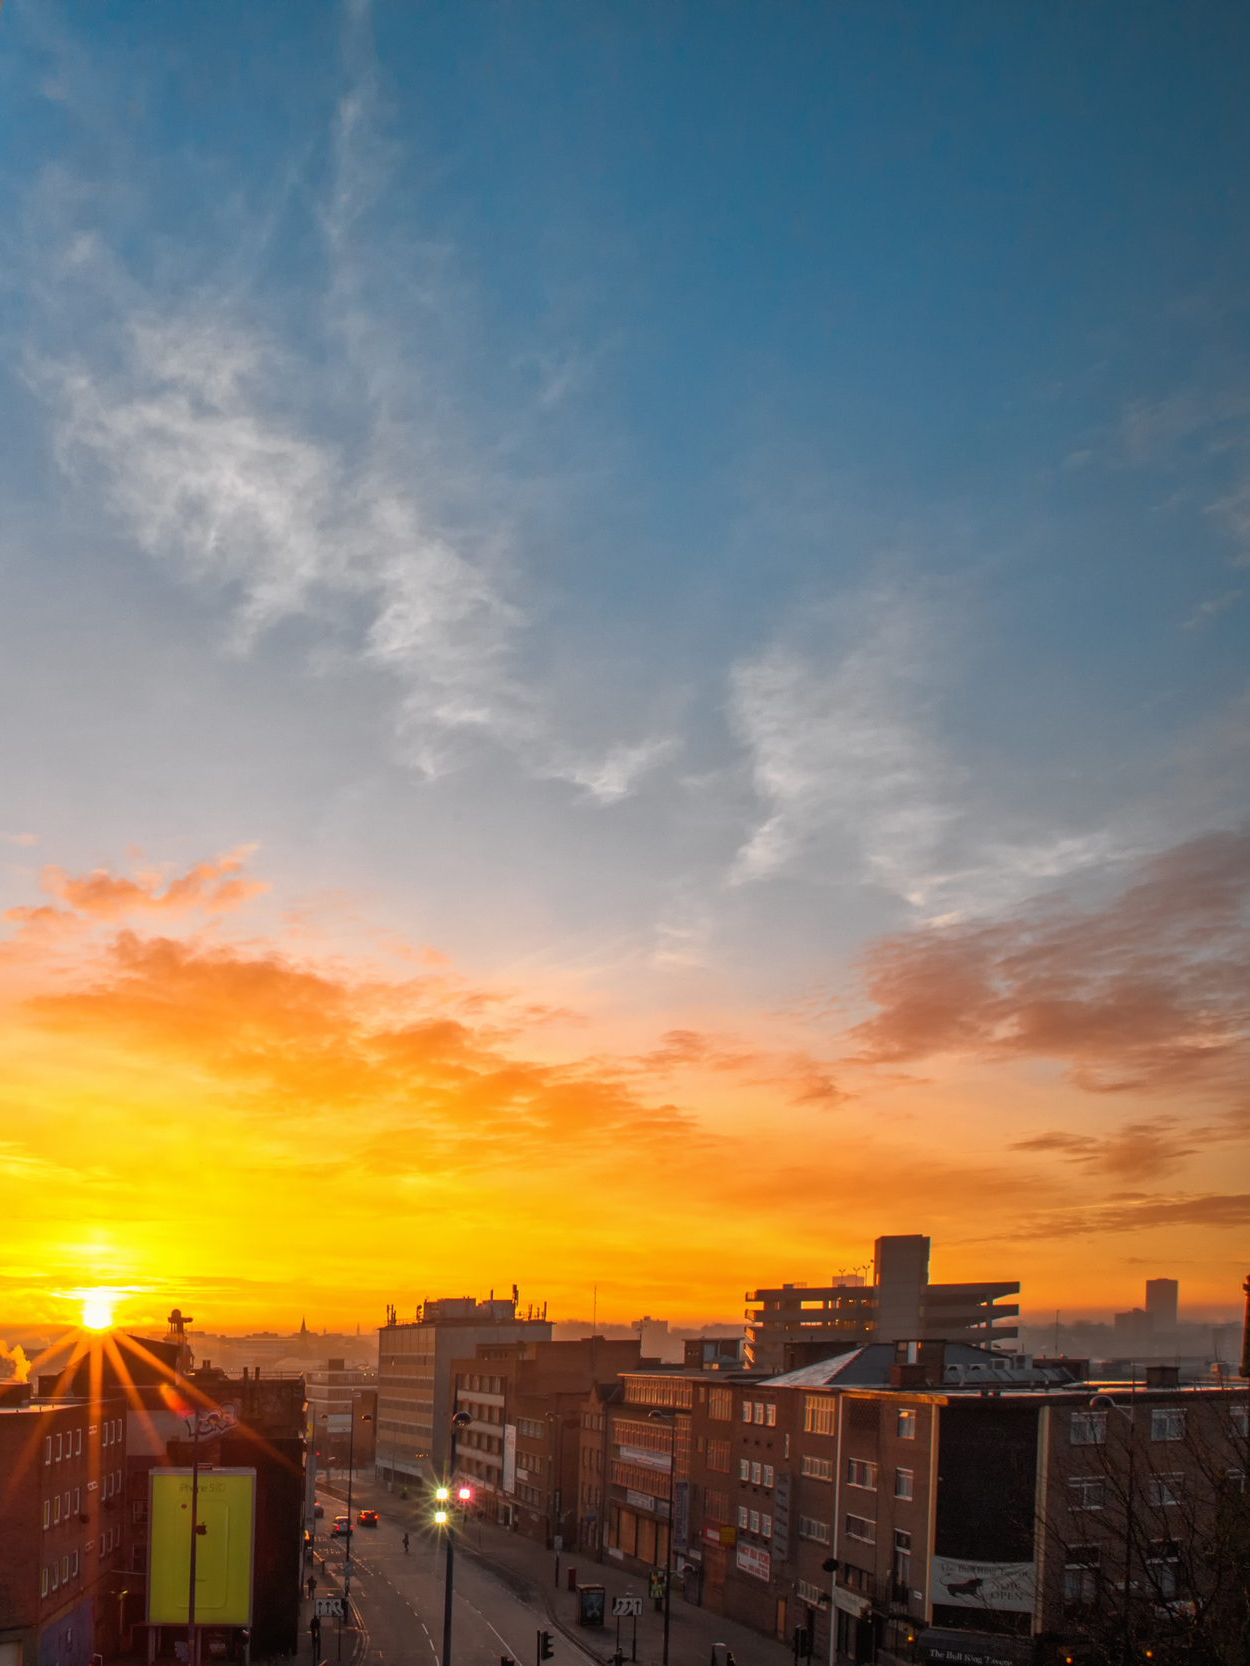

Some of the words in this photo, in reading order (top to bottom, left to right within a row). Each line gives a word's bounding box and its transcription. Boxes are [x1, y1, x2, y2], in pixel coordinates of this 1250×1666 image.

[990, 1592, 1023, 1601] OPEN
[929, 1649, 945, 1659] The
[946, 1651, 962, 1661] Bull
